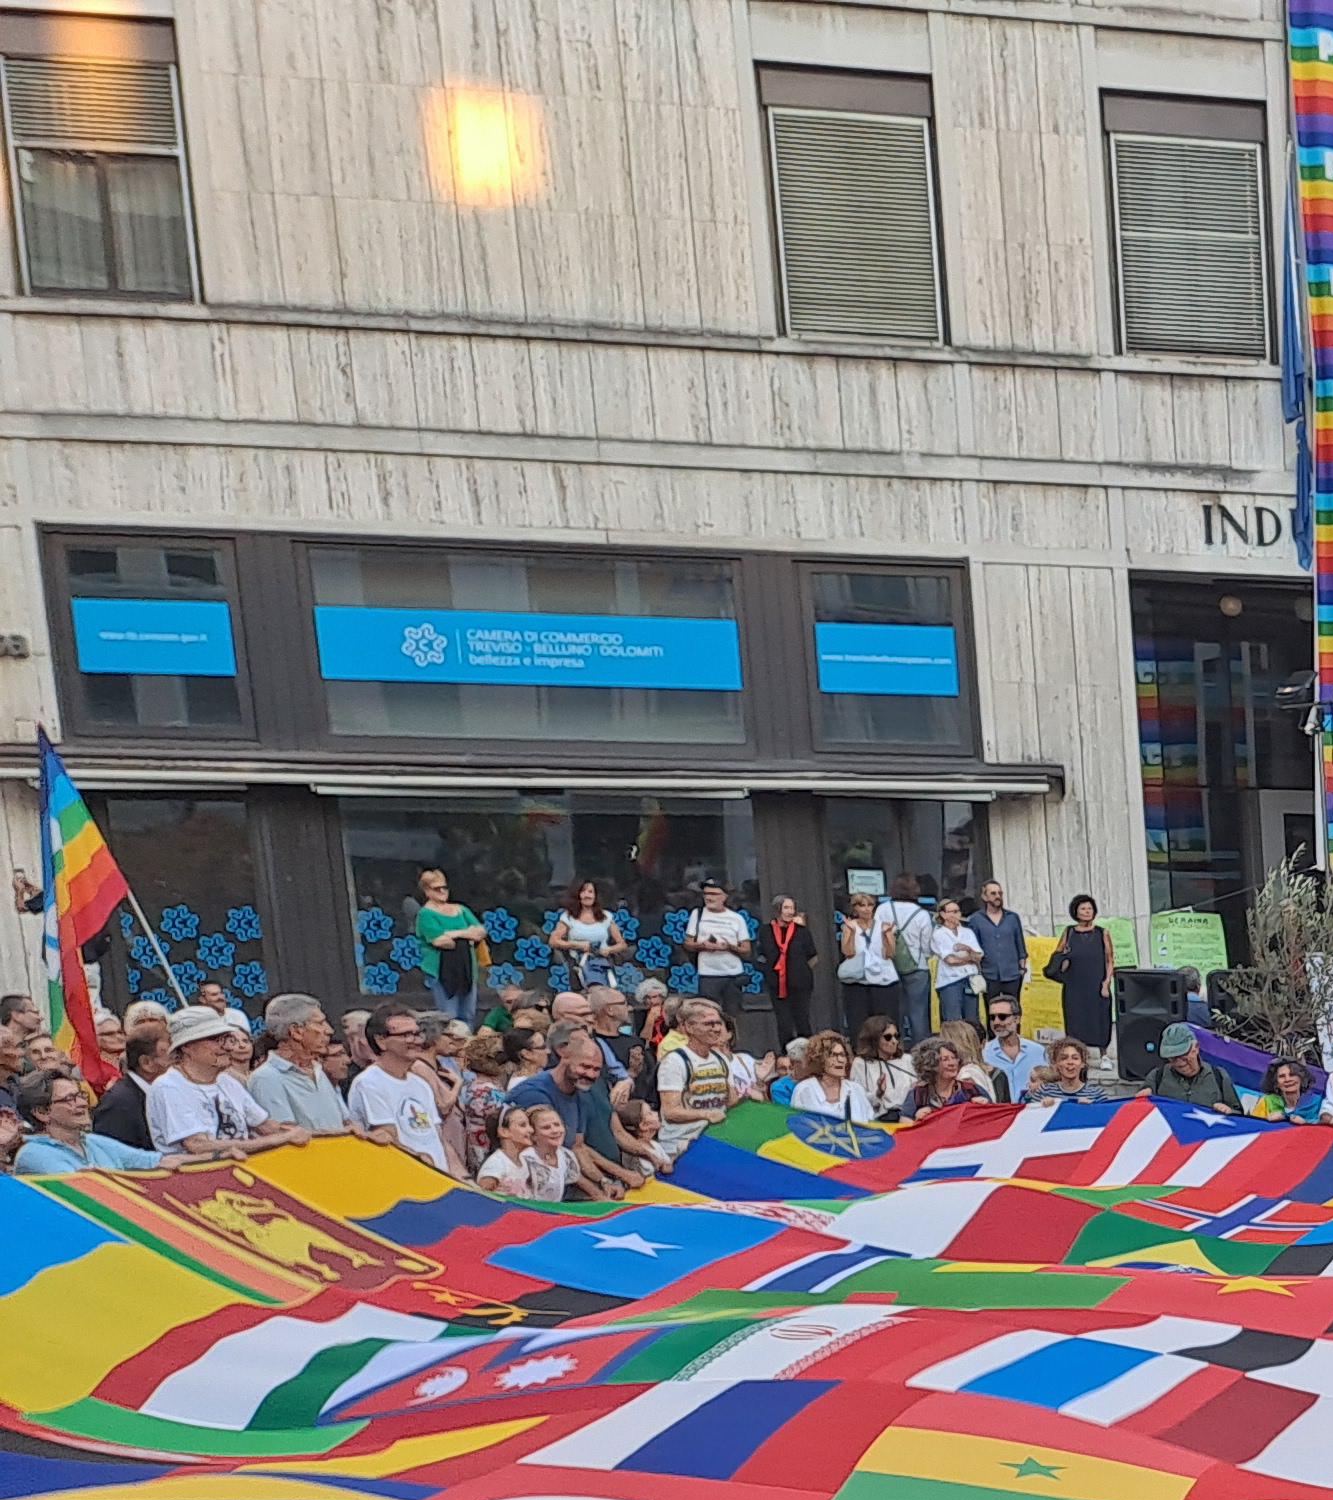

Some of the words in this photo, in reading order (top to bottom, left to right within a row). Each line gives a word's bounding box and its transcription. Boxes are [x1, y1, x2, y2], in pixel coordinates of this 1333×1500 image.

[466, 628, 523, 643] CAMERA
[524, 629, 540, 643] DI
[541, 630, 623, 645] COMMERCIO
[467, 640, 524, 654] TREVISO
[532, 642, 593, 656] BELLUNO
[469, 654, 521, 667] bellezza
[523, 658, 532, 667] e
[534, 656, 586, 669] impresa
